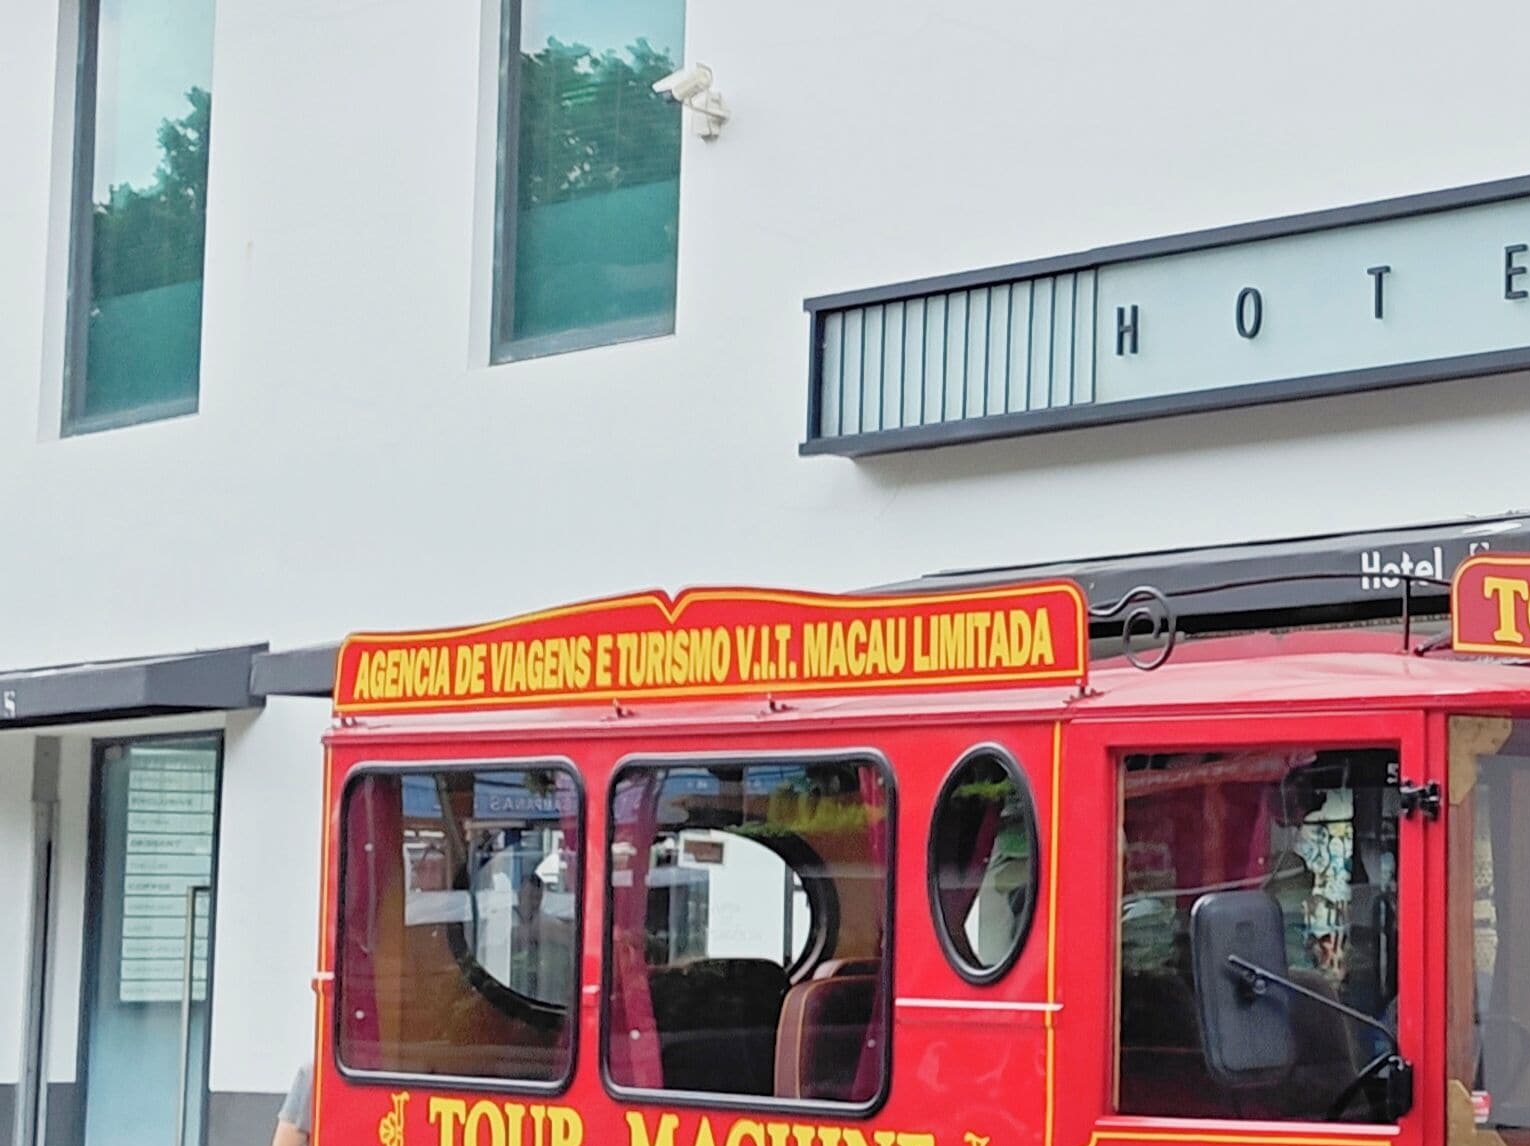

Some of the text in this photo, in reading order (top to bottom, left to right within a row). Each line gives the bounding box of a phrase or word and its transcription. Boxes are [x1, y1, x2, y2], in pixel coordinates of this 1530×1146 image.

[1361, 546, 1443, 590] Hotel
[352, 607, 1055, 699] AGENCIA DE VIAGENS E TURISMO V.I.T. MACAU LIMITADA
